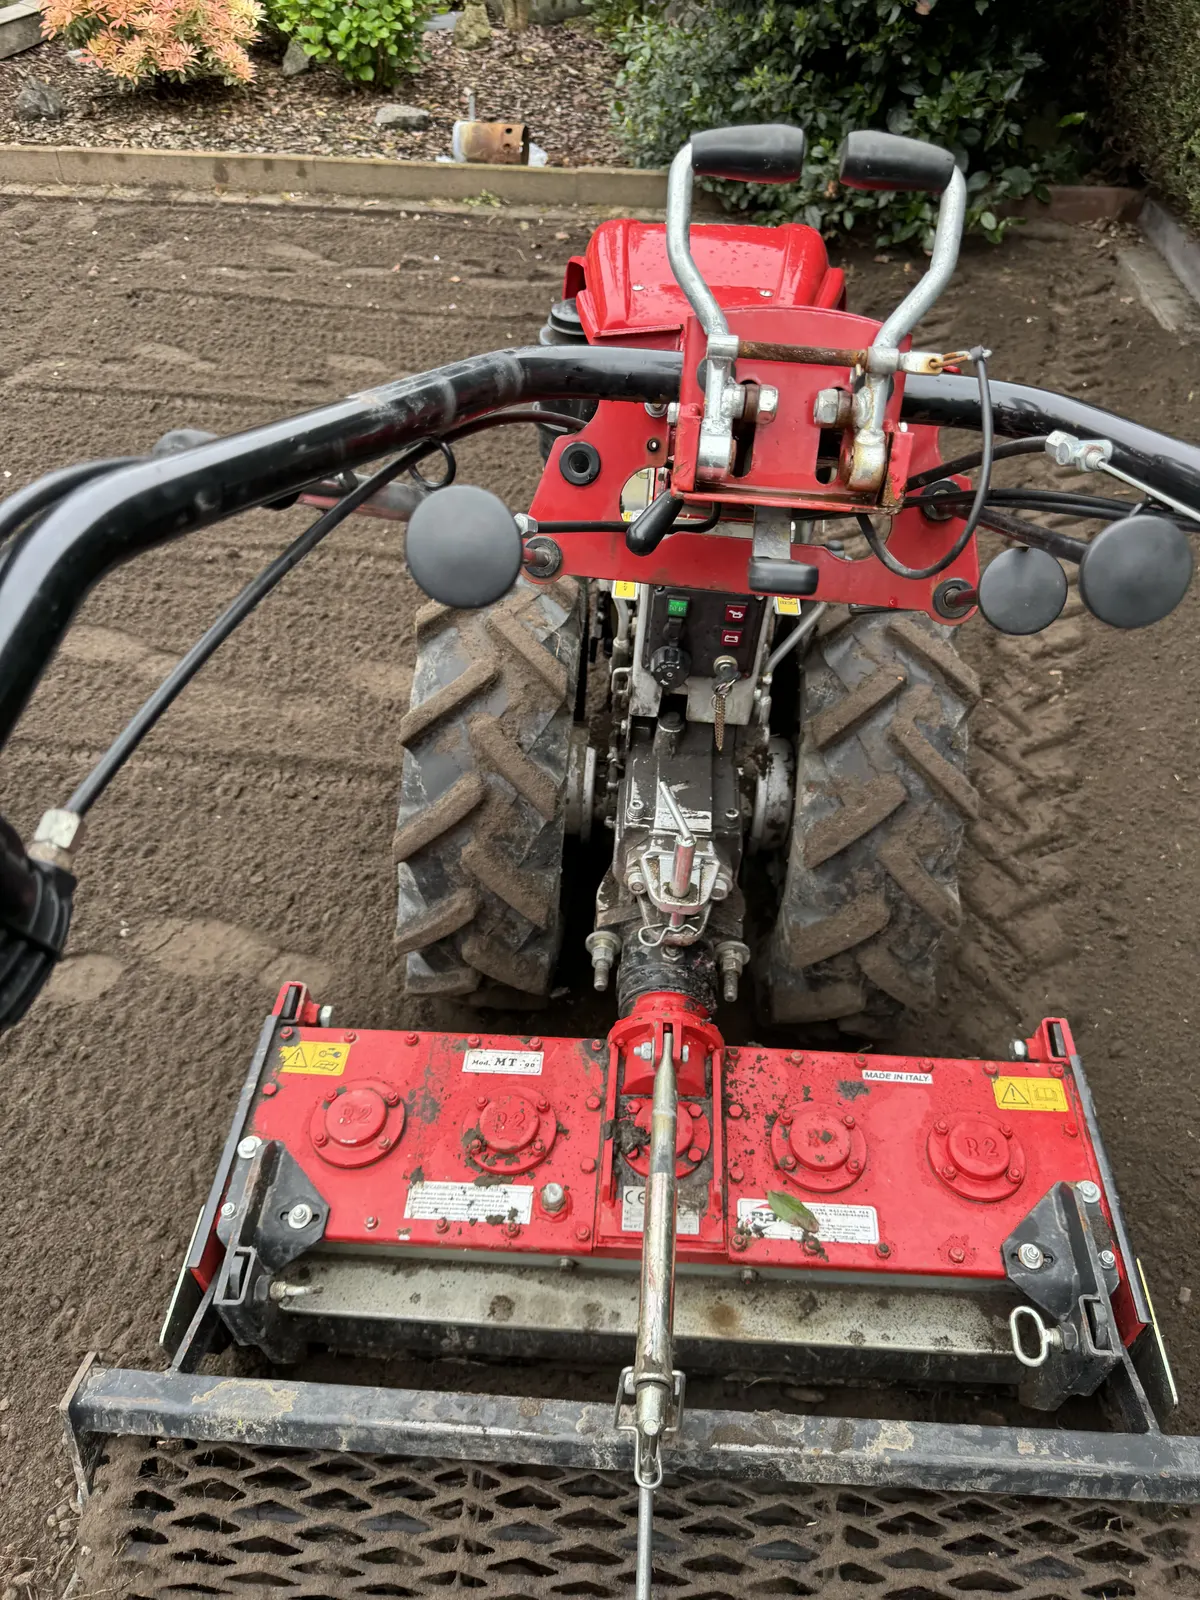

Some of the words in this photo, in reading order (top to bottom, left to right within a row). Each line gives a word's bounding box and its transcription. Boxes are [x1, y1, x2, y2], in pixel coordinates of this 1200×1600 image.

[494, 1057, 518, 1067] MT
[905, 1074, 930, 1082] ITALY
[964, 1136, 1000, 1158] R2
[625, 1190, 645, 1205] CE
